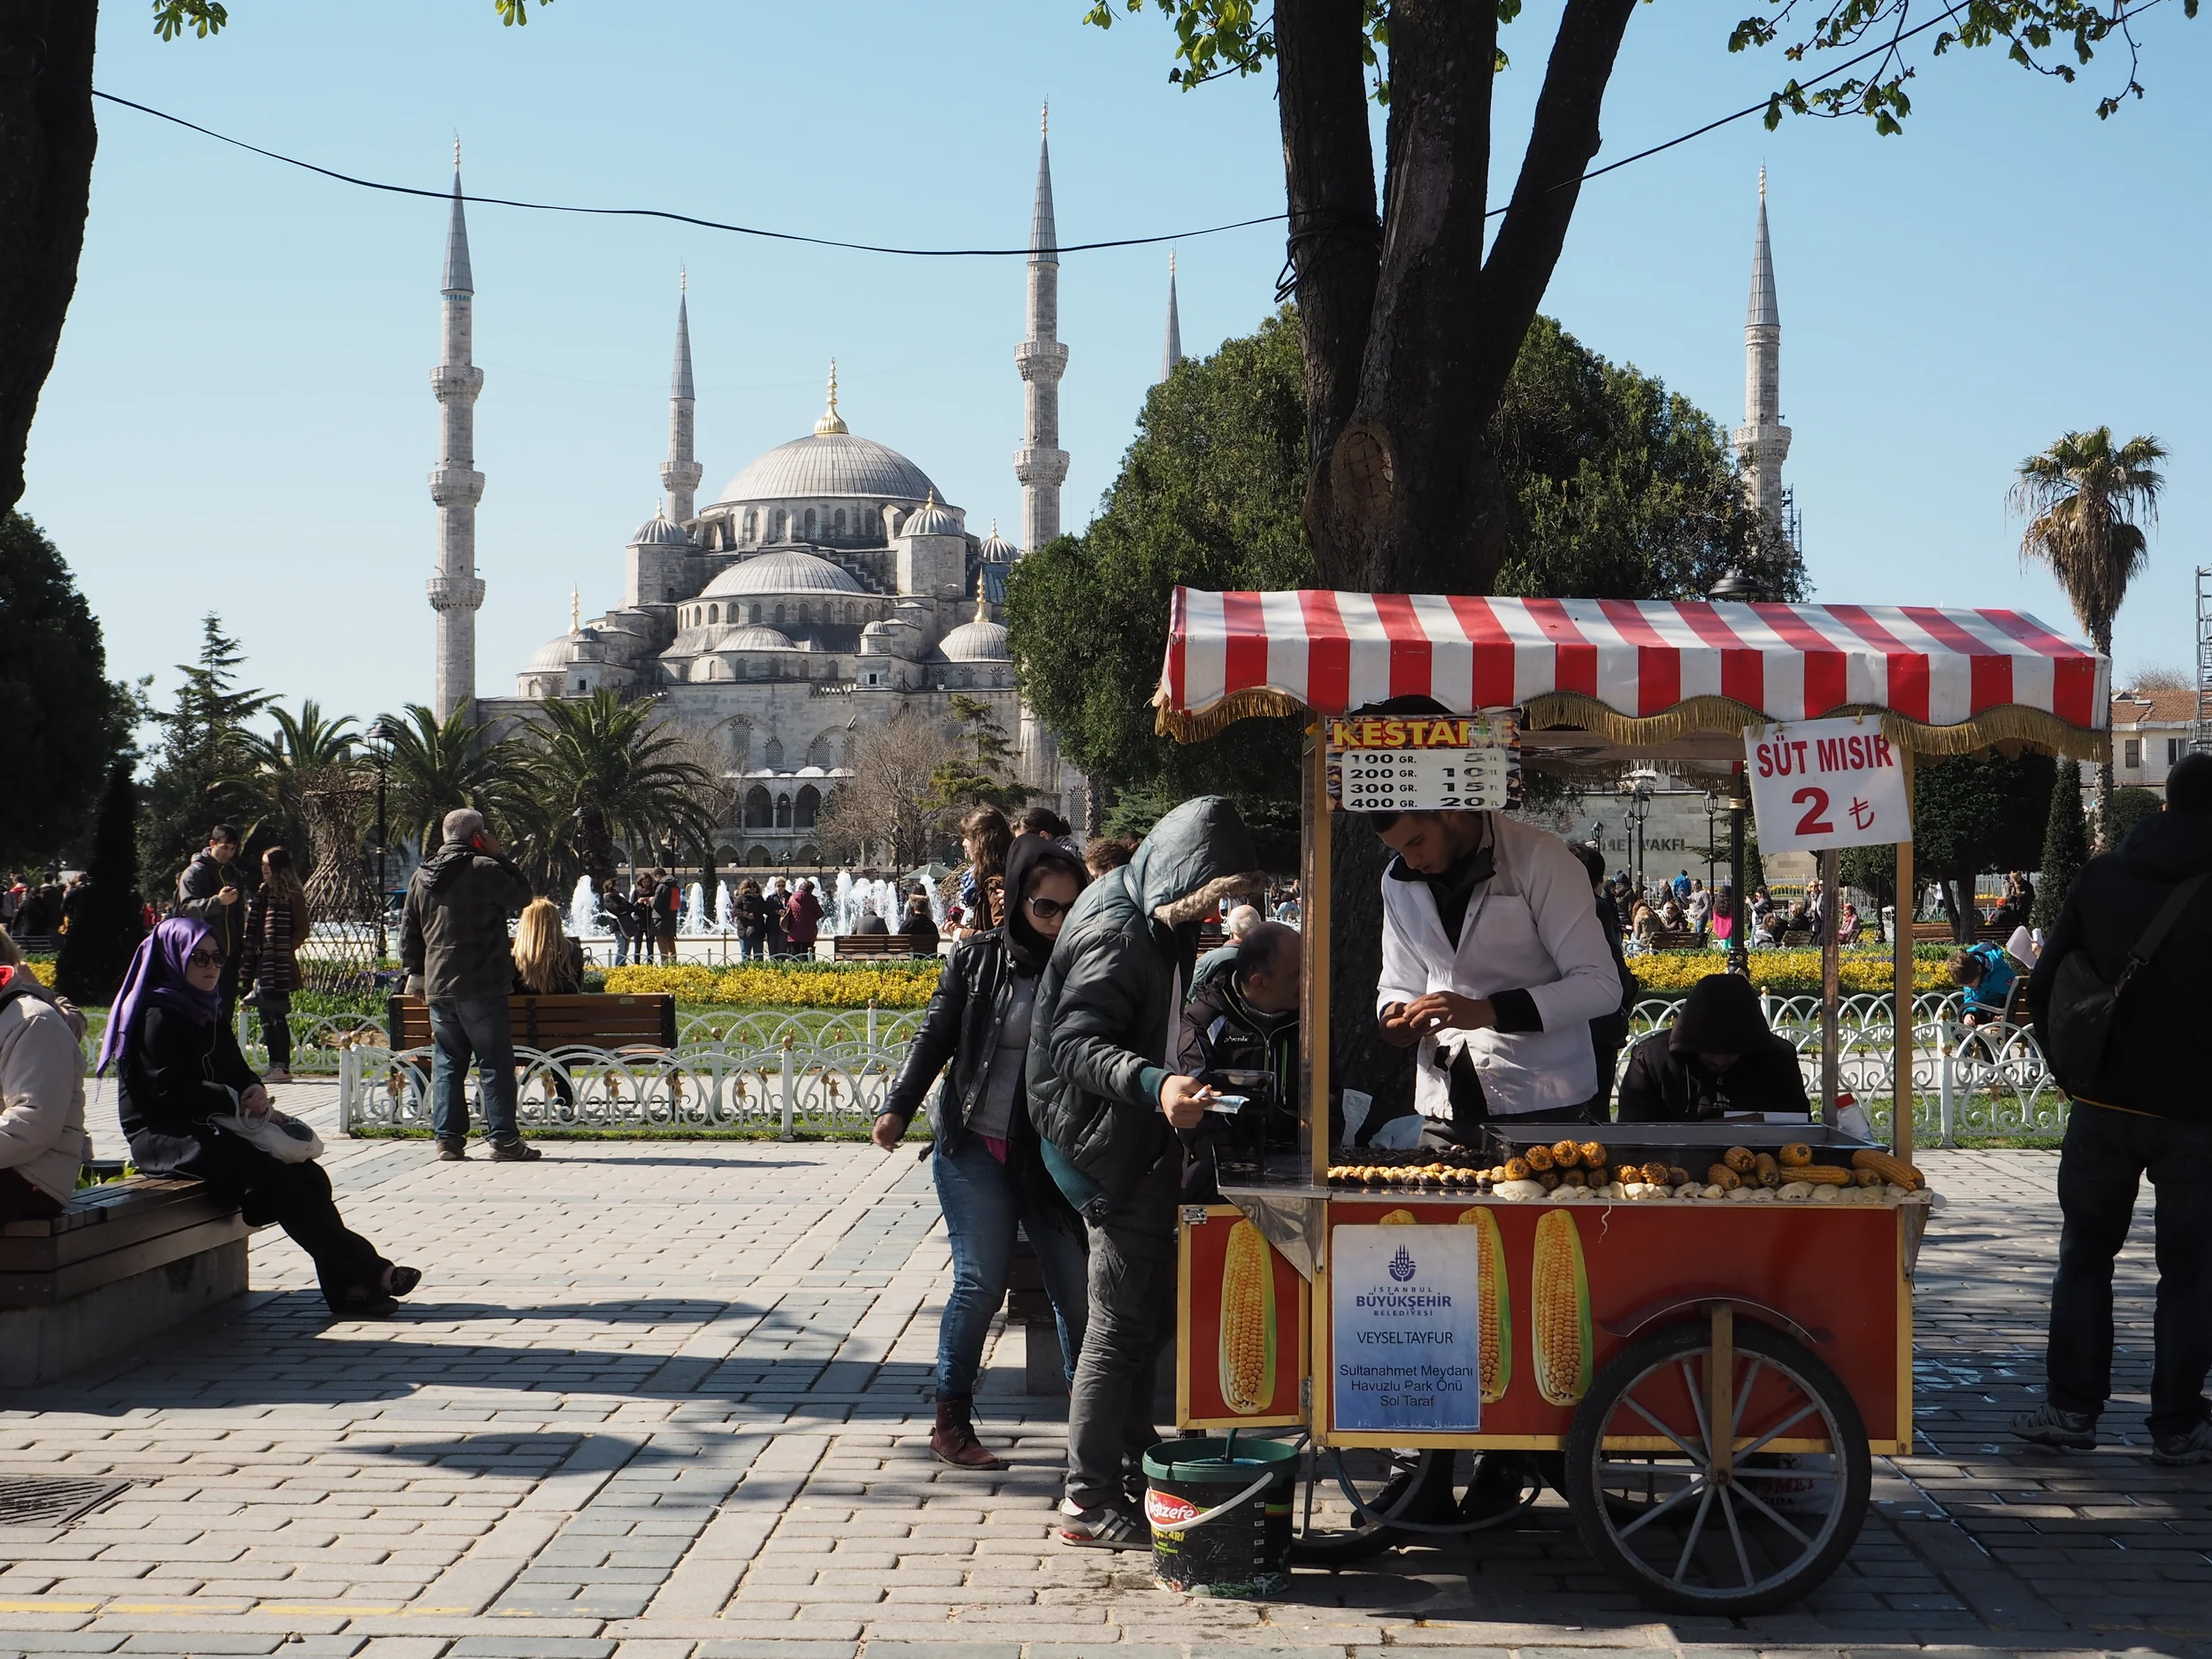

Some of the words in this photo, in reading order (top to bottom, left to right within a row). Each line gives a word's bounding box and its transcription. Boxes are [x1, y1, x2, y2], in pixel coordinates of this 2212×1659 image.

[1350, 754, 1394, 764] 100
[1463, 752, 1485, 763] 5
[1756, 735, 1808, 778] SÜT
[1816, 734, 1893, 772] MISIR
[1349, 769, 1394, 779] 200
[1441, 767, 1485, 778] 10
[1349, 783, 1394, 794] 300
[1442, 781, 1486, 792] 15
[1349, 798, 1394, 808] 400
[1440, 797, 1486, 807] 20
[1792, 787, 1834, 835] 2
[1356, 1293, 1452, 1310] BÜYÜKŞEHİR
[1340, 1364, 1417, 1377] Sultanahmet
[1421, 1364, 1473, 1379] Meydanı
[1351, 1379, 1401, 1392] Havuzlu
[1404, 1379, 1433, 1392] Park
[1436, 1379, 1463, 1392] Önü
[1380, 1394, 1400, 1407] Sol
[1402, 1394, 1435, 1407] Taraf
